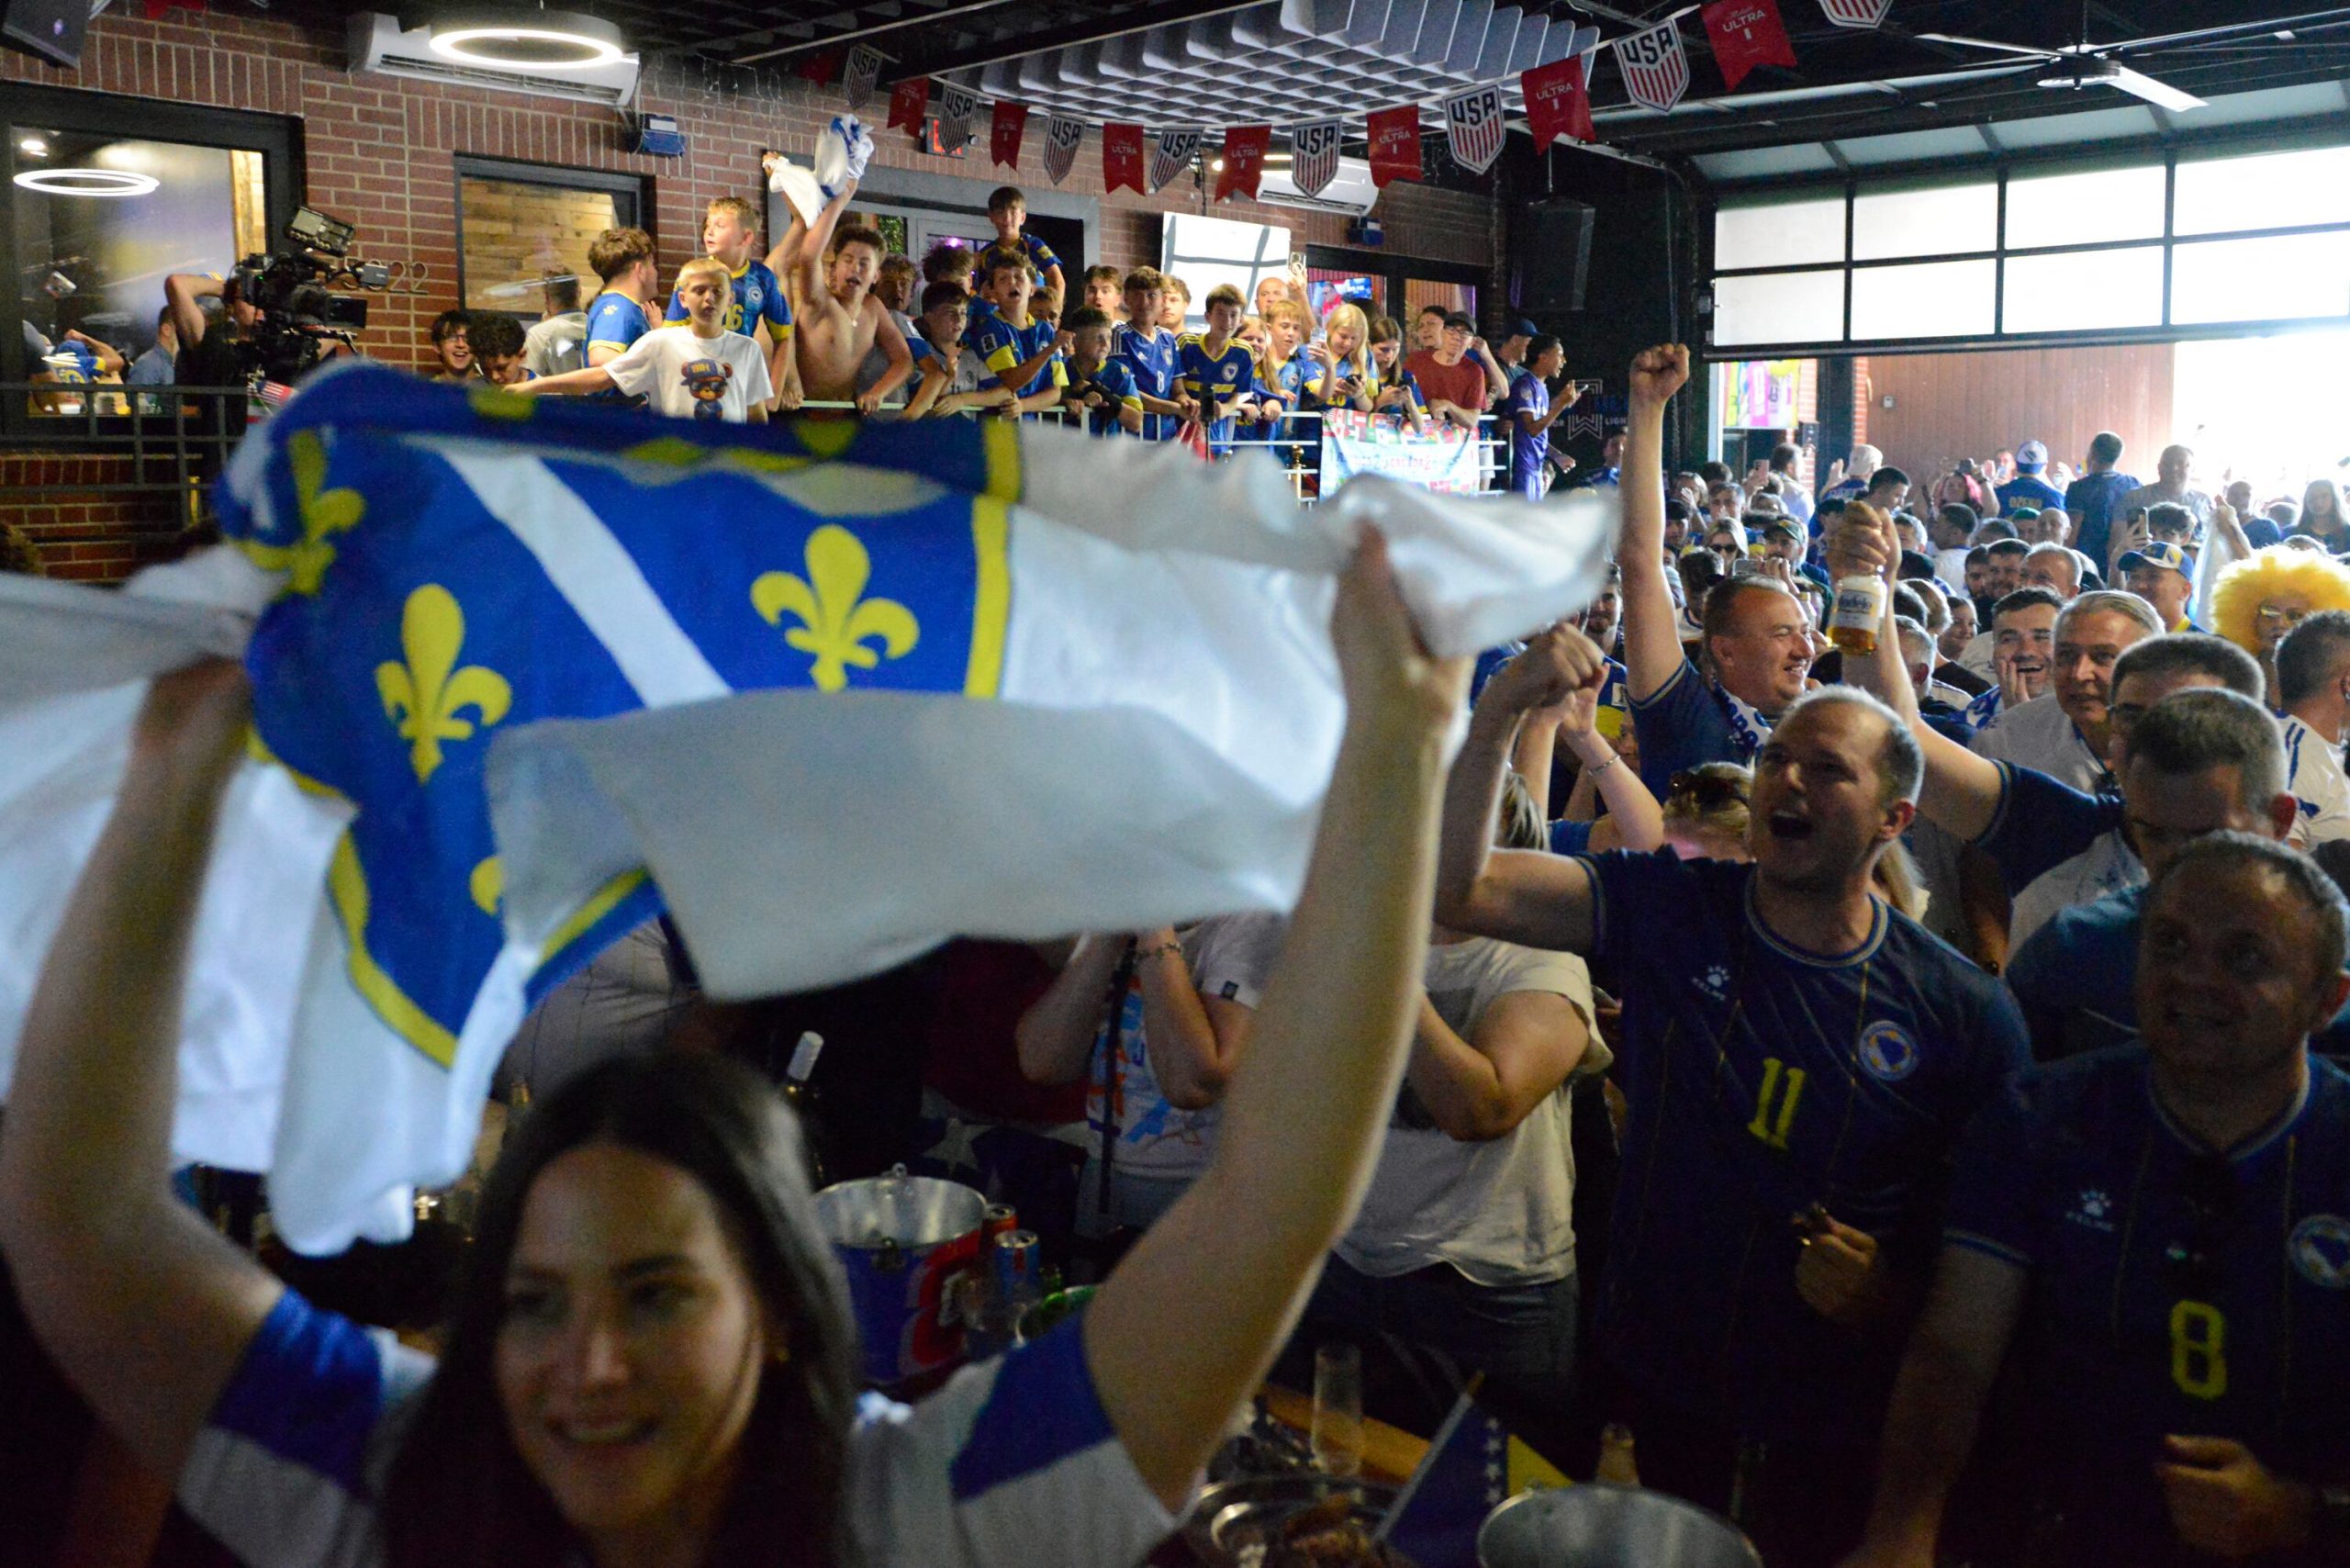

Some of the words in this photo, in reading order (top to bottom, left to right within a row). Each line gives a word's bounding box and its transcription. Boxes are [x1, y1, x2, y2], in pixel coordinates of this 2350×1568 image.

[1722, 9, 1766, 32] ULTRA
[1622, 27, 1673, 64] USA
[852, 51, 878, 75] USA
[1536, 83, 1573, 100] ULTRA
[946, 93, 973, 118] USA
[1450, 92, 1496, 126] USA
[1051, 119, 1081, 146] USA
[1163, 132, 1199, 158] USA
[1296, 126, 1336, 155] USA
[1379, 130, 1411, 144] ULTRA
[1111, 145, 1137, 155] ULTRA
[1231, 148, 1259, 158] ULTRA
[1157, 370, 1165, 394] 8
[1747, 1058, 1807, 1150] 11
[2169, 1299, 2228, 1402] 8
